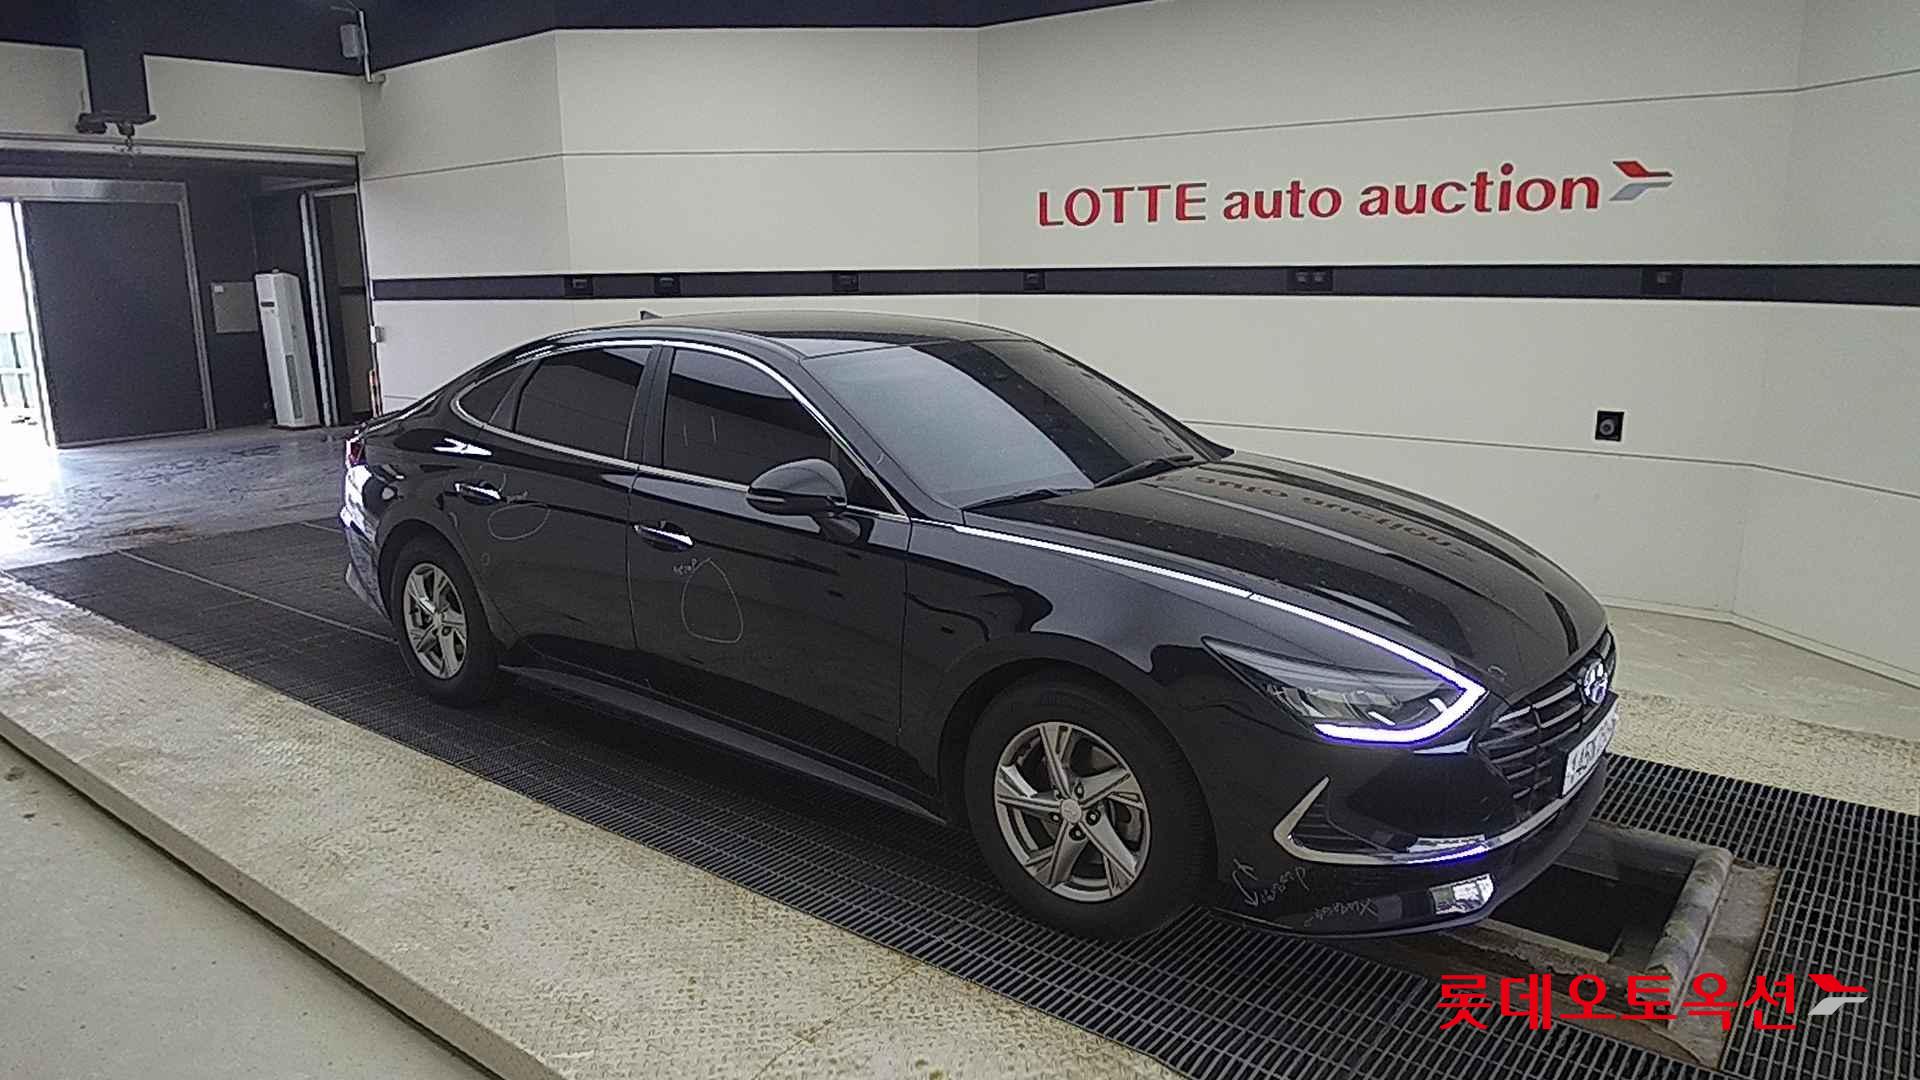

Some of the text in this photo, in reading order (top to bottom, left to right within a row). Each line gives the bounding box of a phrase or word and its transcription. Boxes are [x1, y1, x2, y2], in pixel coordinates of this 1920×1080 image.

[1039, 163, 1601, 227] LOTTE auto auction
